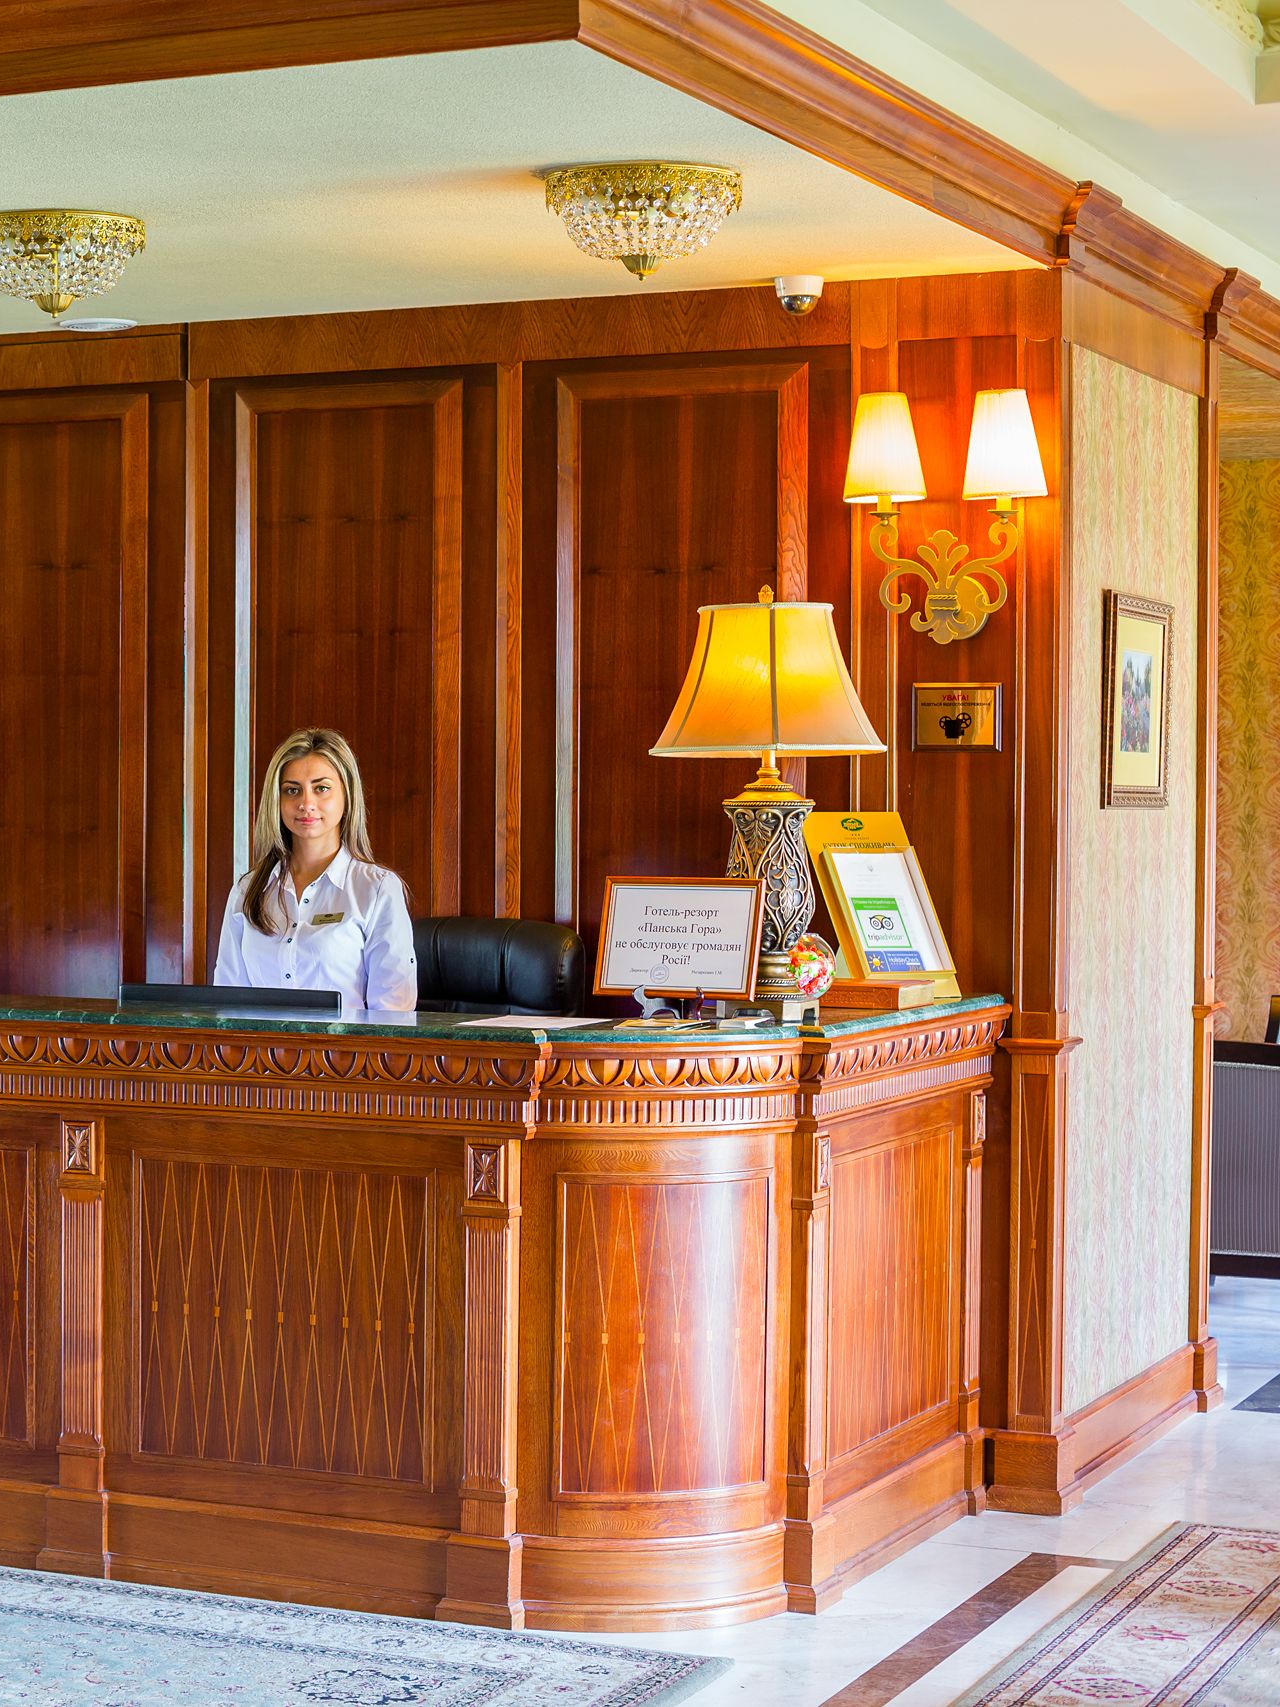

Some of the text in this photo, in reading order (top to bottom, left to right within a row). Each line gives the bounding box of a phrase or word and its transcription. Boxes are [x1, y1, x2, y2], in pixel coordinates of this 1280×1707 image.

[644, 905, 720, 919] Готель-резорт
[637, 922, 722, 936] «Панська Гора»
[867, 932, 903, 941] tripadvisor
[615, 938, 742, 953] не обслуговує громадян
[661, 955, 691, 966] Росії!
